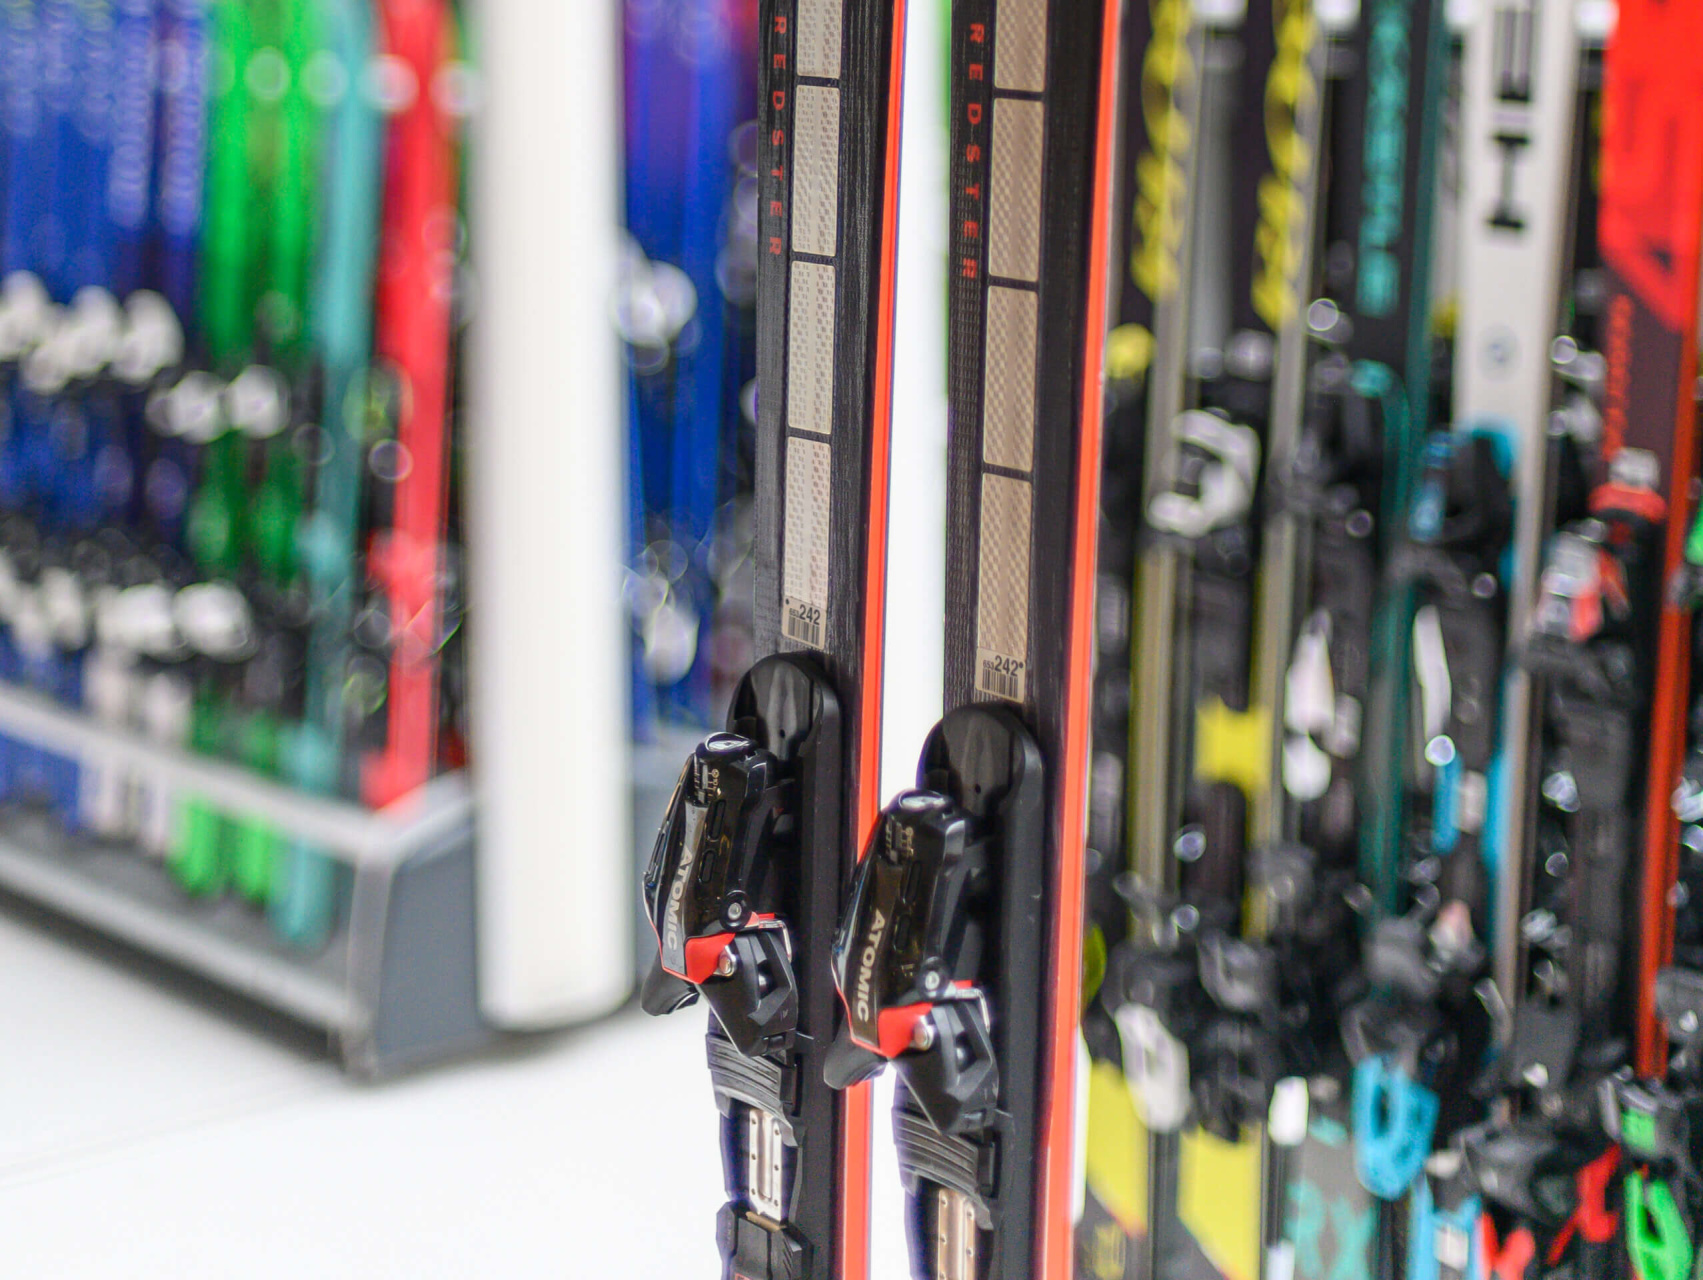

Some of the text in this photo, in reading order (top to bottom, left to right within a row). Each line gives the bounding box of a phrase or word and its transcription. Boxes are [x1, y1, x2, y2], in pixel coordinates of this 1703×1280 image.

[769, 16, 787, 255] REDSTER
[963, 23, 984, 279] REDSTER
[799, 603, 821, 626] 242
[994, 655, 1019, 677] 242
[667, 846, 693, 951] ATOMIC
[856, 908, 886, 1023] ATOMIC
